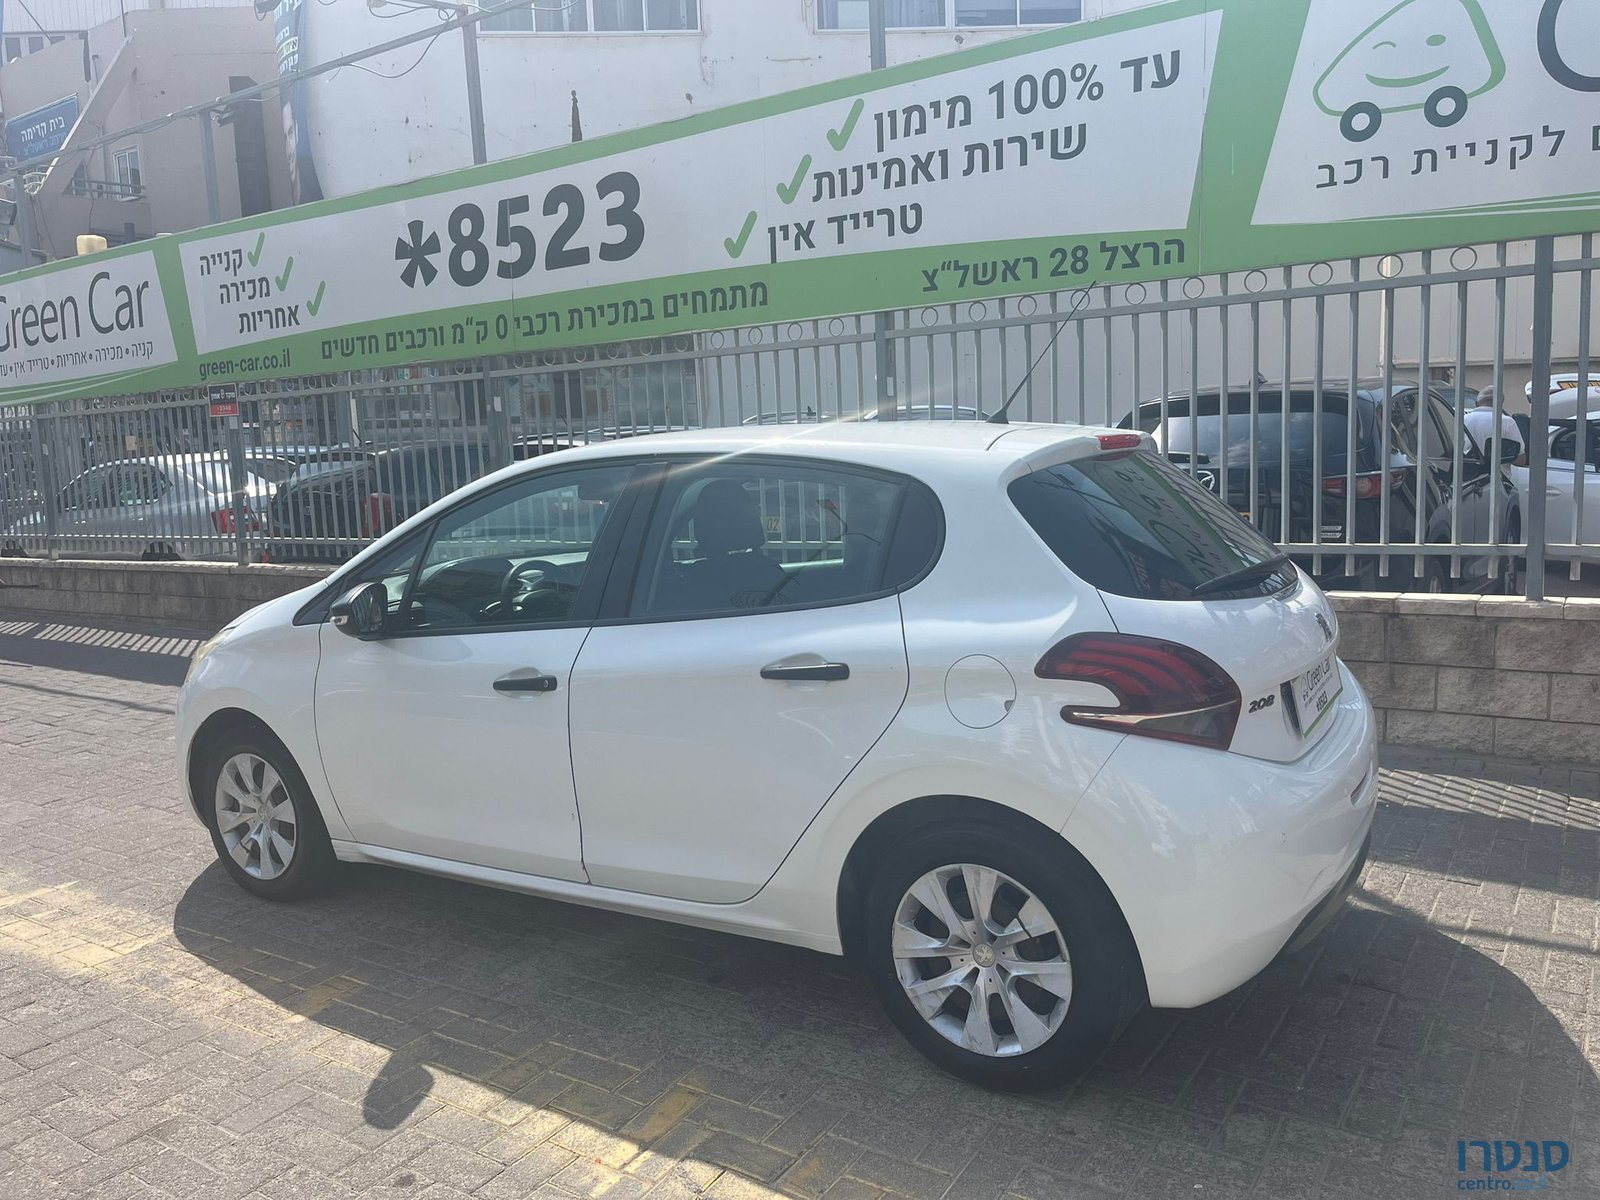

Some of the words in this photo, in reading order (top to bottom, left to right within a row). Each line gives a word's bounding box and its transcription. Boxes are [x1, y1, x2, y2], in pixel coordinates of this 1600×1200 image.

[1120, 49, 1181, 93] עד
[988, 62, 1104, 120] 100%
[50, 116, 66, 132] בית
[874, 95, 972, 153] מימון
[962, 123, 1087, 176] שירות
[1411, 125, 1565, 175] לקניית
[812, 149, 949, 202] ואמינות
[1316, 155, 1389, 188] רכב
[827, 202, 923, 244] טרייד
[768, 221, 816, 264] אין
[1100, 238, 1185, 271] הרצל
[200, 248, 242, 277] קנייה
[1050, 246, 1089, 278] 28
[88, 272, 149, 334] Car
[220, 276, 271, 304] מכירה
[663, 281, 768, 319] מתמחים
[239, 304, 300, 334] אחריות
[494, 314, 506, 340] 0
[514, 311, 560, 337] רכבי
[568, 297, 655, 332] במכירת
[95, 345, 123, 362] מכירה
[132, 341, 154, 360] קניה
[321, 333, 380, 360] חדשים
[385, 324, 445, 352] ורכבים
[14, 360, 26, 378] אין
[27, 356, 49, 372] טרייד
[56, 350, 87, 368] אחריות
[199, 347, 290, 380] green-car.co.il
[1248, 694, 1275, 714] 208
